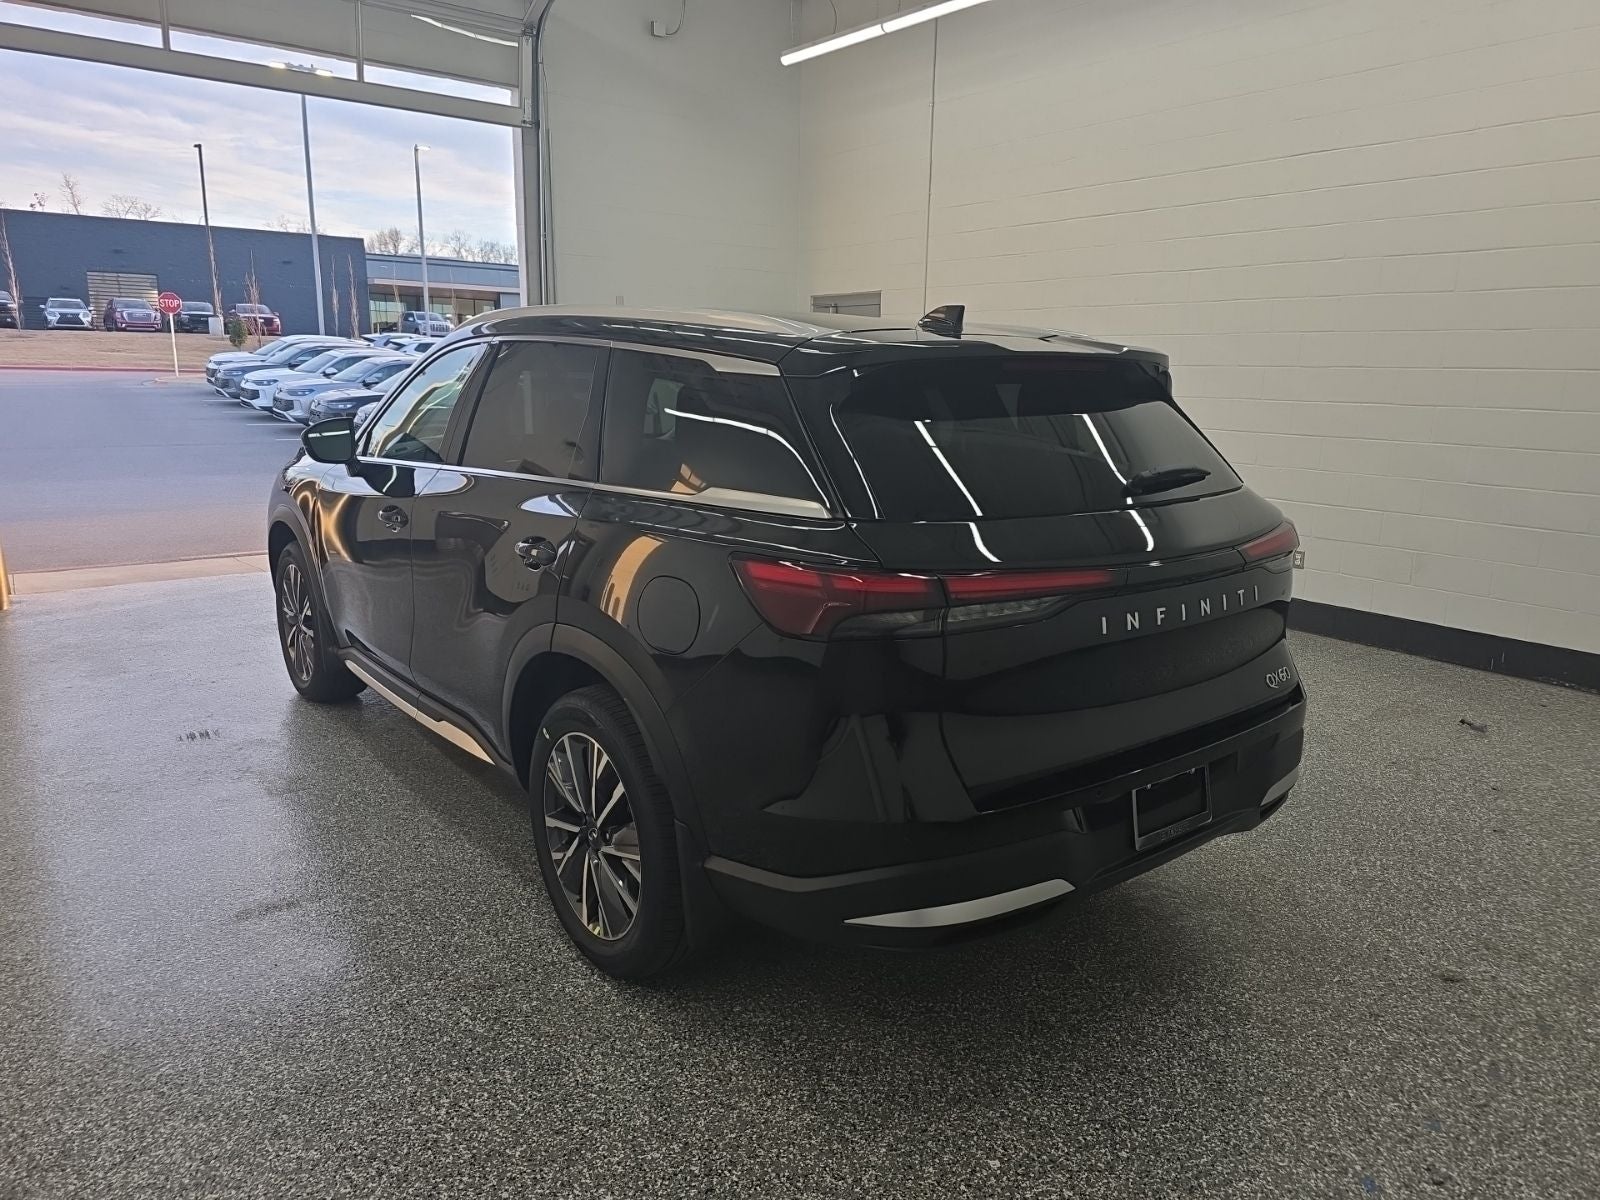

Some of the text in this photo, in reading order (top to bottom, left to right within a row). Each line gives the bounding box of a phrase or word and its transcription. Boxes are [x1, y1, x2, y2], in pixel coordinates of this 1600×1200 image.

[160, 300, 180, 308] STOP
[1101, 585, 1259, 635] INFINITI
[1265, 666, 1291, 688] QX60
